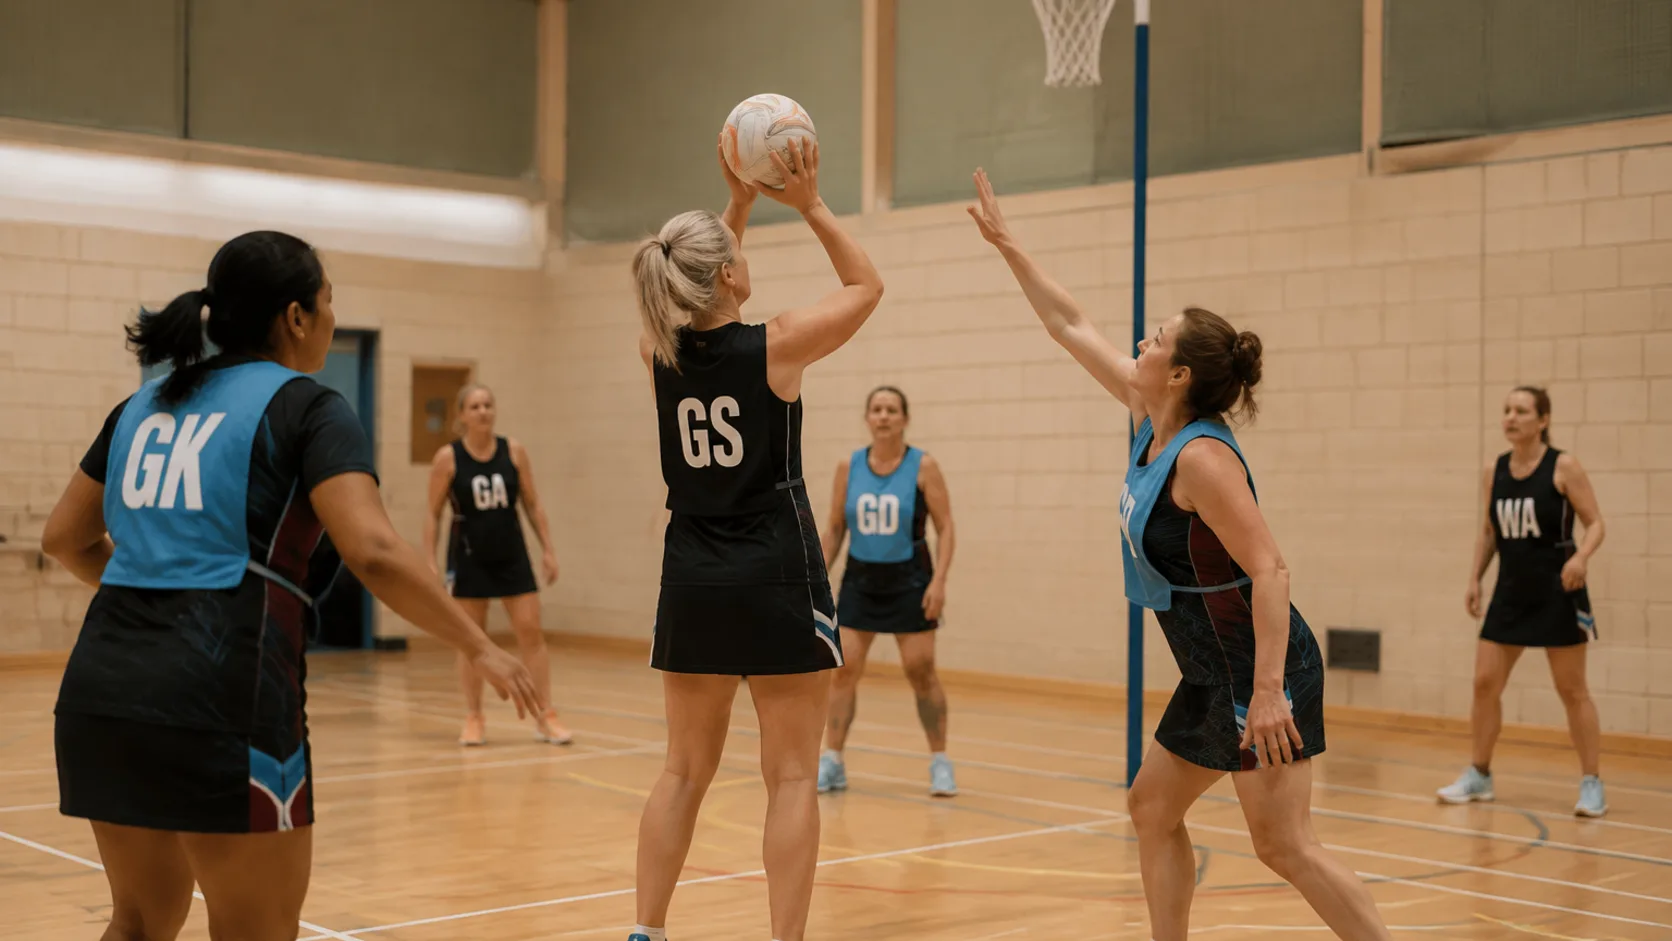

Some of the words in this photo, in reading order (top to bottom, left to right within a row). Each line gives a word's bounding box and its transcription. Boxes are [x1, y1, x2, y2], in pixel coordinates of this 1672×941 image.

[677, 395, 744, 468] GS
[122, 413, 226, 511] GK
[472, 474, 508, 511] GA
[857, 494, 901, 536] GD
[1496, 498, 1542, 538] WA
